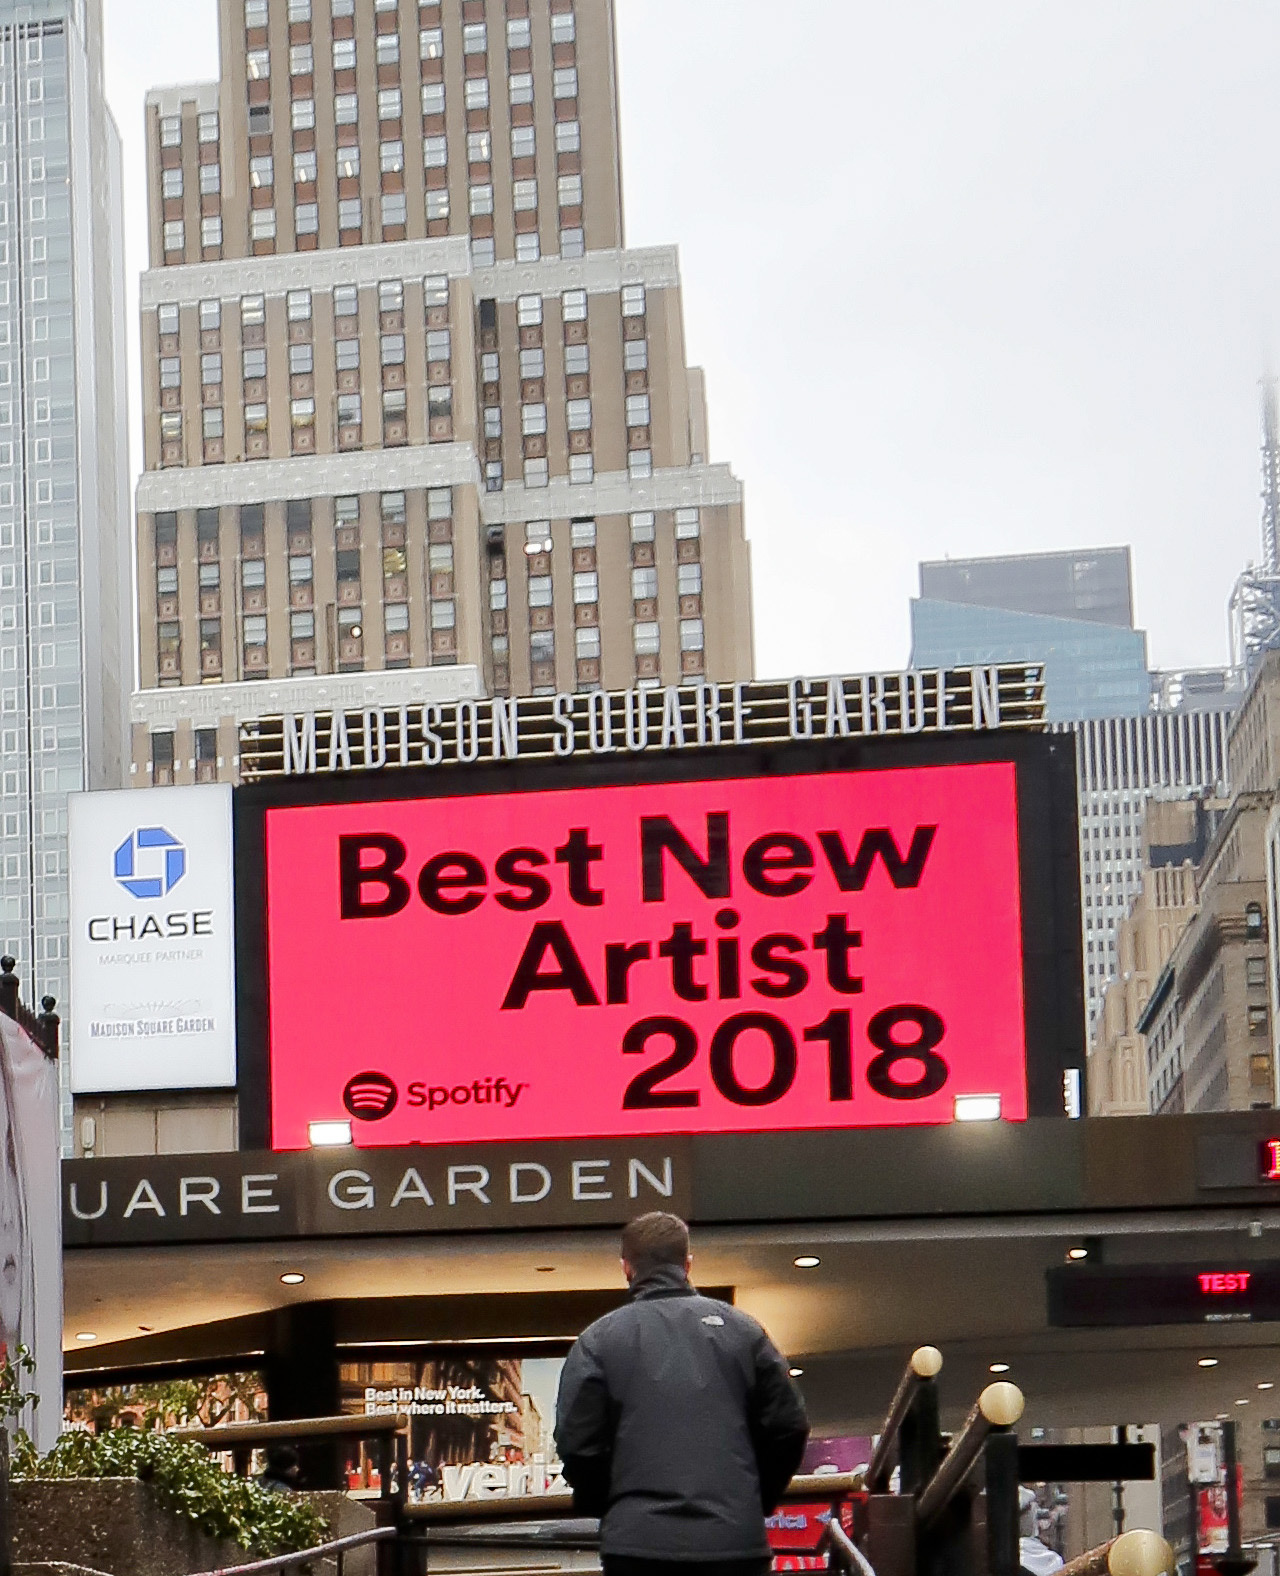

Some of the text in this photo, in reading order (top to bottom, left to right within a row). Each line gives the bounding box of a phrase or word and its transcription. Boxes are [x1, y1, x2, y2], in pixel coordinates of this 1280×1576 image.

[282, 665, 1000, 775] MADISON SQUARE GARDEN
[339, 811, 938, 920] Best New
[88, 910, 213, 941] CHASE
[98, 949, 203, 965] MARQUEE PARTNER
[500, 908, 864, 1010] Artist
[91, 1021, 135, 1038] MADISON
[176, 1017, 215, 1033] GARDEN
[622, 1003, 951, 1111] 2018
[407, 1076, 524, 1111] Spotify
[70, 1156, 673, 1220] UARE GARDEN
[1198, 1270, 1251, 1293] TEST
[365, 1385, 485, 1402] Best in New York.
[365, 1400, 518, 1416] Best where it matters.
[443, 1453, 574, 1500] veriz
